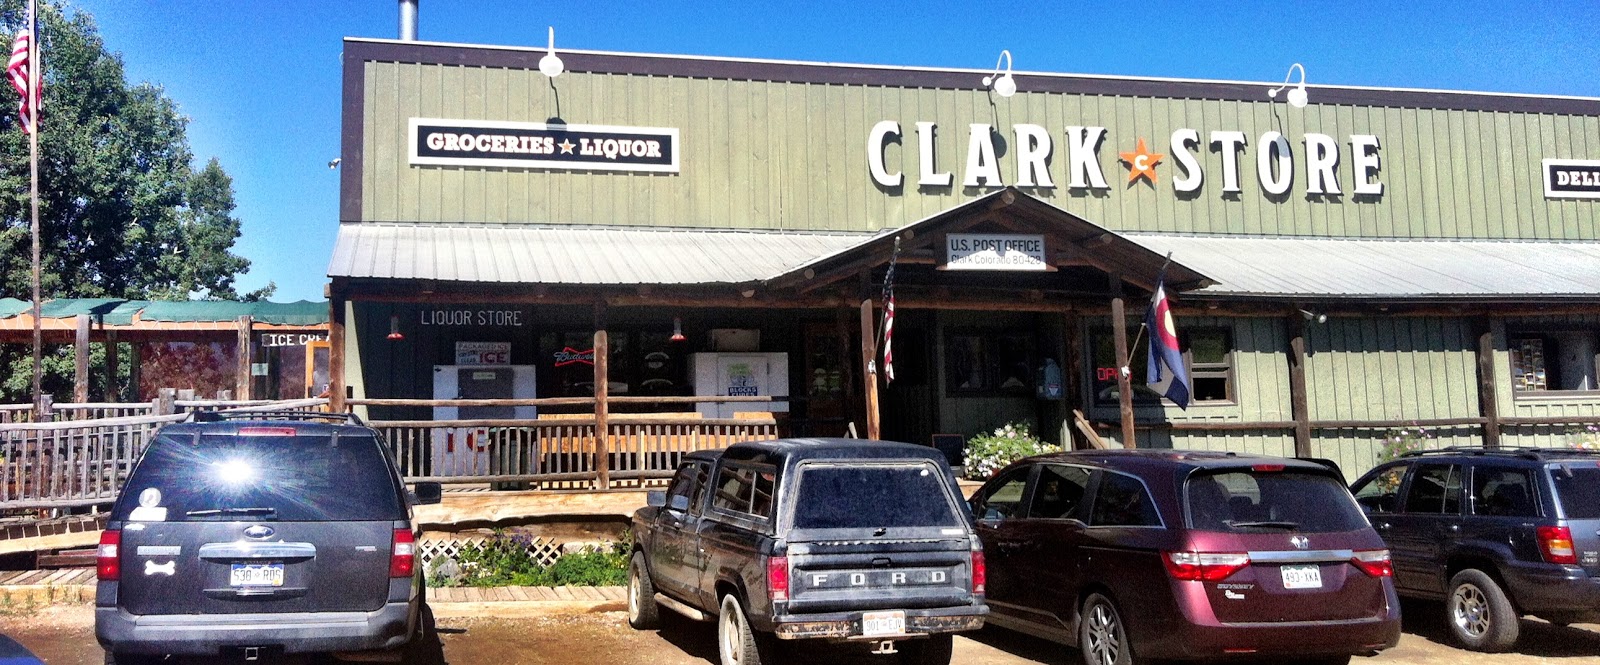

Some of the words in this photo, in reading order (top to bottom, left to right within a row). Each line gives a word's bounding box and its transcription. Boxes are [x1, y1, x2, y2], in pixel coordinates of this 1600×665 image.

[426, 132, 554, 154] GROCERIES
[579, 138, 662, 159] LIQUOR
[867, 120, 1111, 189] CLARK
[1171, 128, 1384, 195] STORE
[951, 239, 971, 252] U.S.
[973, 239, 1002, 252] POST
[1004, 239, 1041, 252] OFFICE
[951, 254, 973, 264] Clark
[974, 254, 1011, 265] Colorado
[421, 310, 472, 326] LIQUOR
[477, 310, 522, 326] STORE
[269, 334, 295, 346] ICE
[480, 352, 507, 364] ICE
[812, 571, 946, 587] FORD
